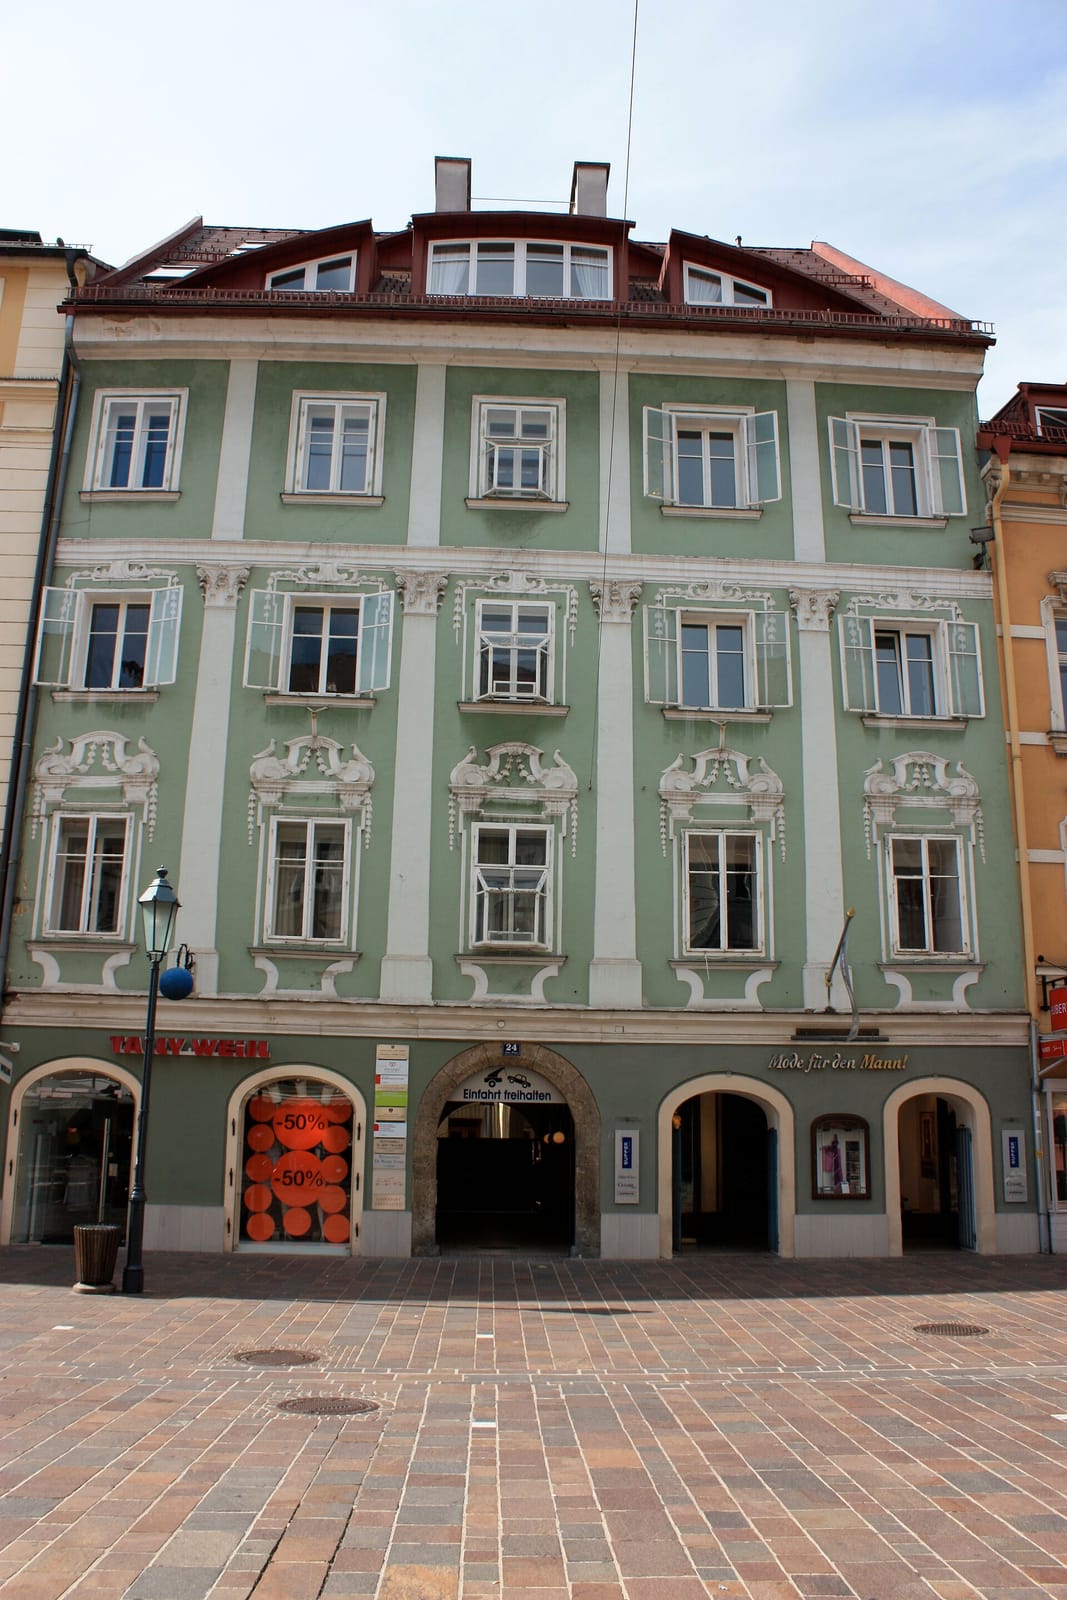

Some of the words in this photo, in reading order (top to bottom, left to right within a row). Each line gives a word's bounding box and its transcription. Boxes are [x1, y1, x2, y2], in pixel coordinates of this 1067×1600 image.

[109, 1035, 185, 1055] TALY
[505, 1043, 518, 1052] 24
[768, 1053, 804, 1069] Mode
[804, 1053, 830, 1073] für
[832, 1053, 856, 1069] den
[860, 1054, 909, 1069] Mann!
[463, 1089, 501, 1100] Einfahrt
[504, 1089, 552, 1101] freihalten
[275, 1114, 325, 1131] -50%
[273, 1170, 323, 1187] -50%
